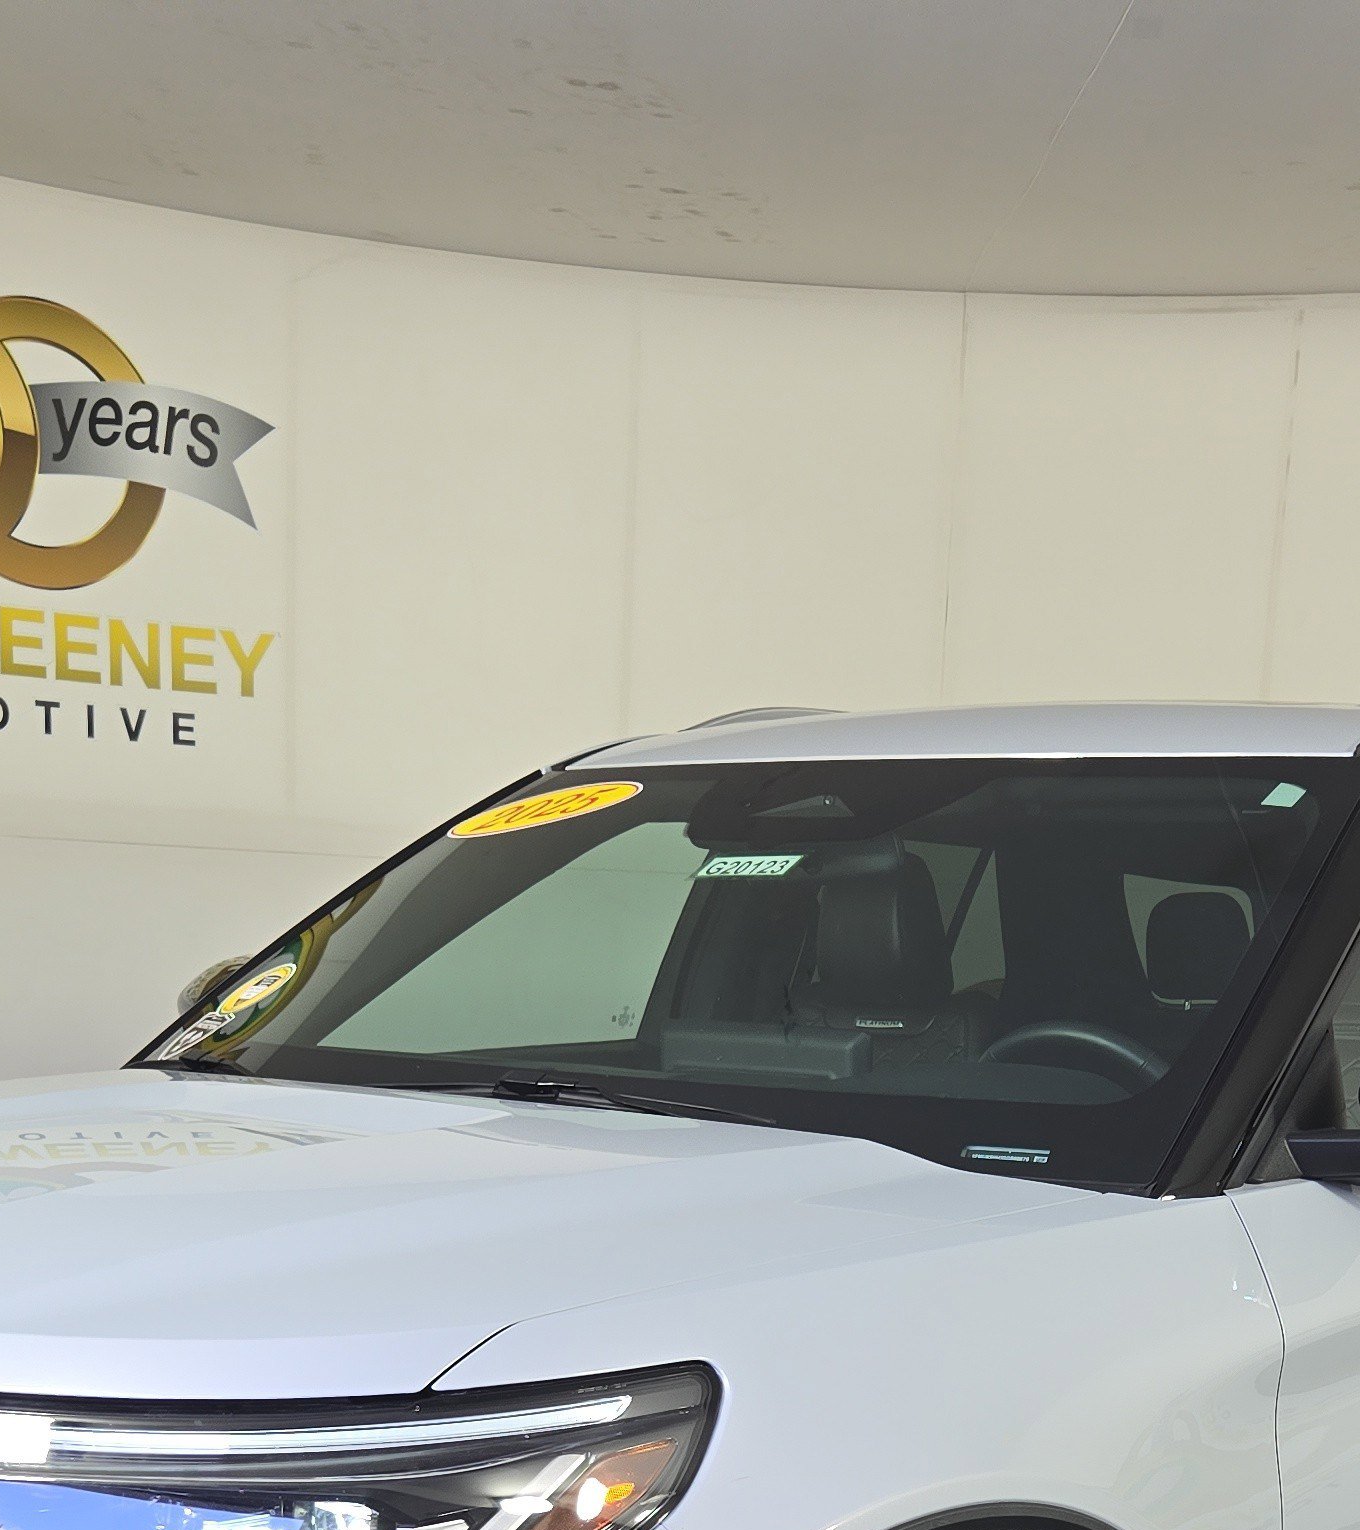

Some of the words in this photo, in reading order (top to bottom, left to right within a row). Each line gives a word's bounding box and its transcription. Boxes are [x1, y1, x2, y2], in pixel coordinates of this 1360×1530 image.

[52, 394, 221, 468] years
[471, 787, 620, 829] 2025
[705, 859, 791, 877] G20123
